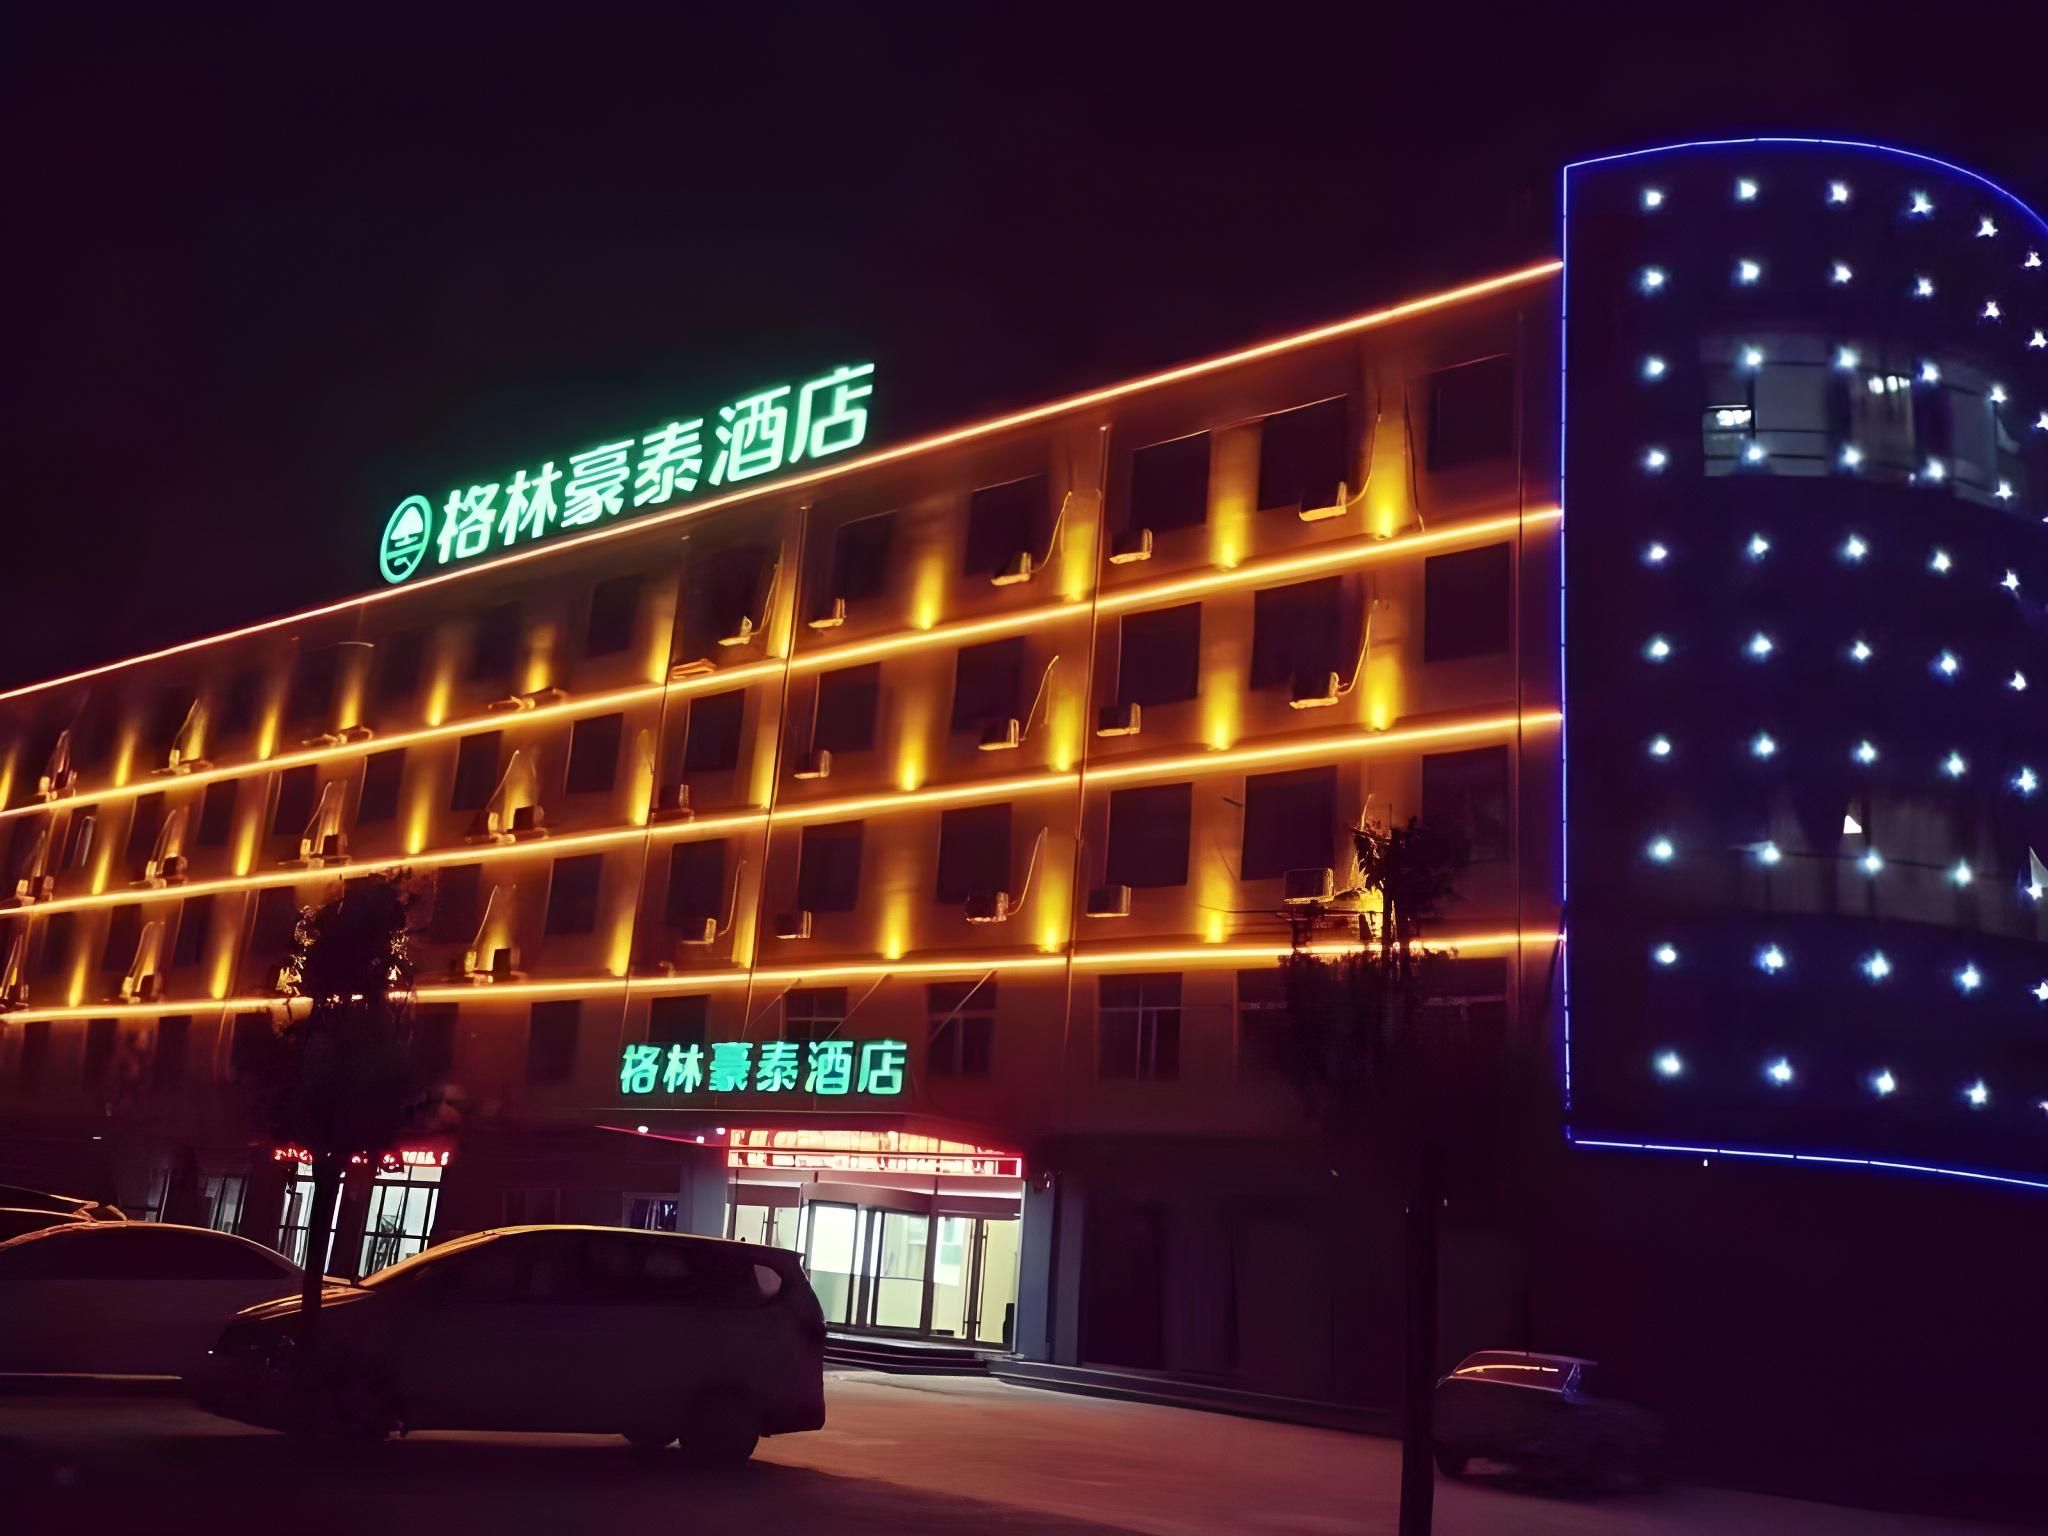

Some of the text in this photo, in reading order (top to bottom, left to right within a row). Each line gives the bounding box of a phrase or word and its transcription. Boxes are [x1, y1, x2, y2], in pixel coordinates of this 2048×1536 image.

[436, 363, 875, 565] 格林豪泰酒店
[619, 1040, 908, 1095] 格林豪泰酒店
